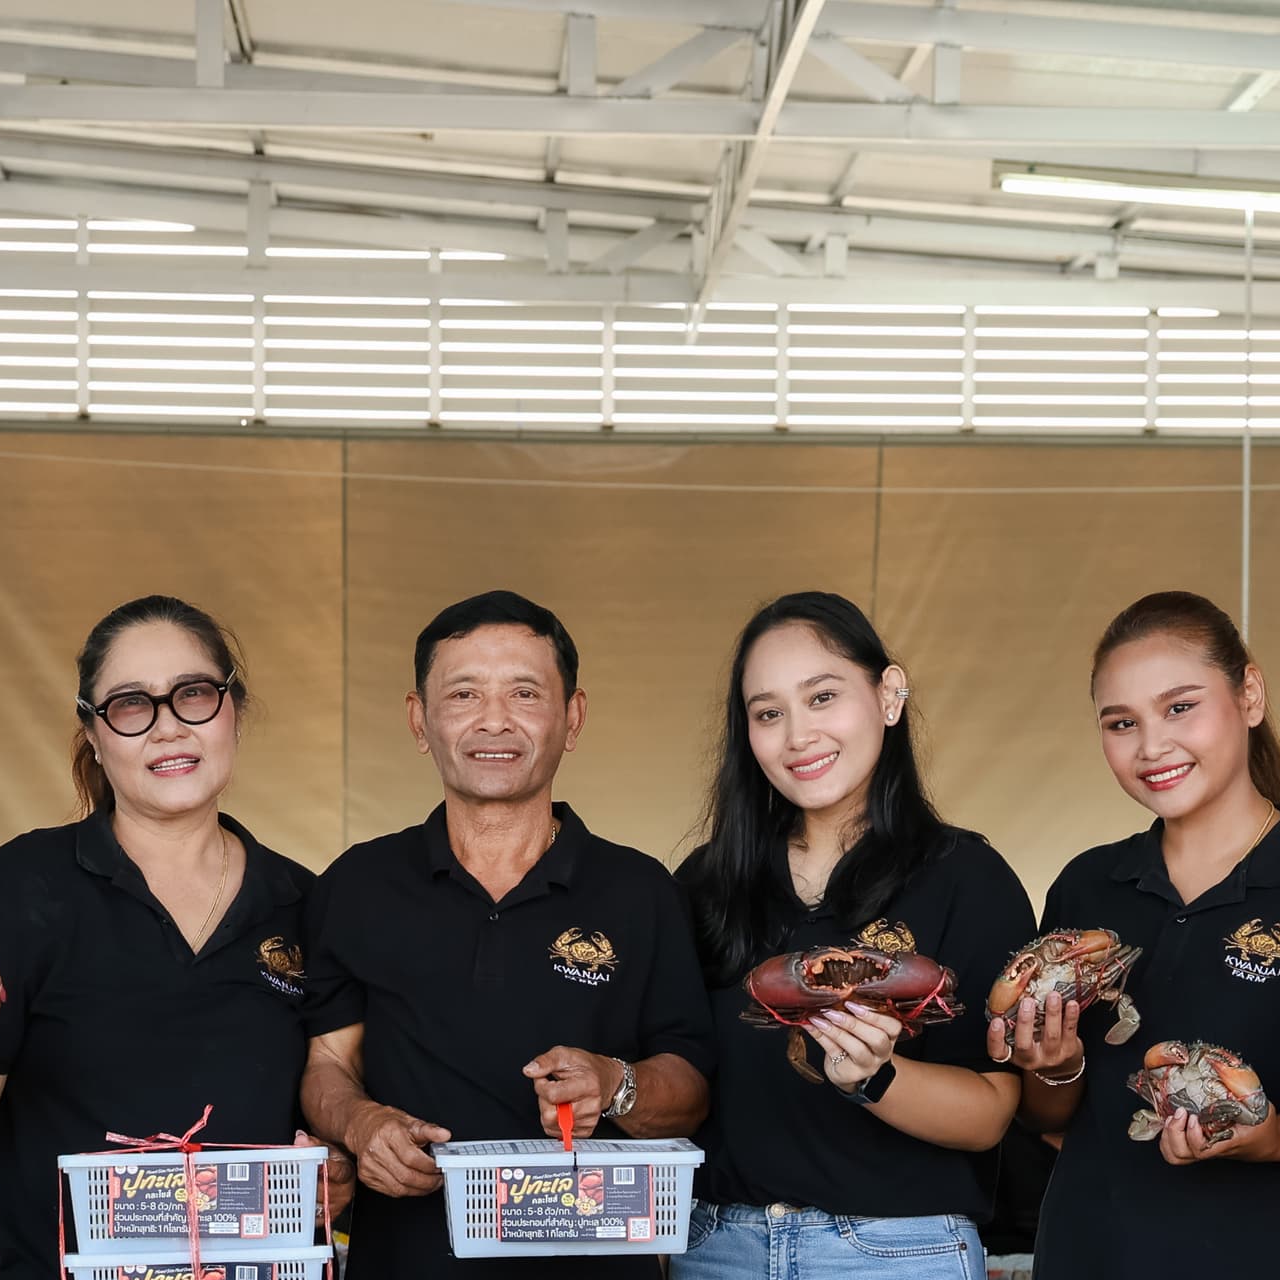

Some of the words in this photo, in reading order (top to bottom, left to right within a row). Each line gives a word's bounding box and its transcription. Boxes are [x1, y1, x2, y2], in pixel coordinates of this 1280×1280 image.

[553, 963, 610, 982] KWANJAI
[1231, 969, 1267, 983] FARM
[510, 1175, 573, 1204] ปูทะเล
[528, 1206, 543, 1215] 5-8
[214, 1214, 237, 1222] 100%
[601, 1218, 624, 1226] 100%
